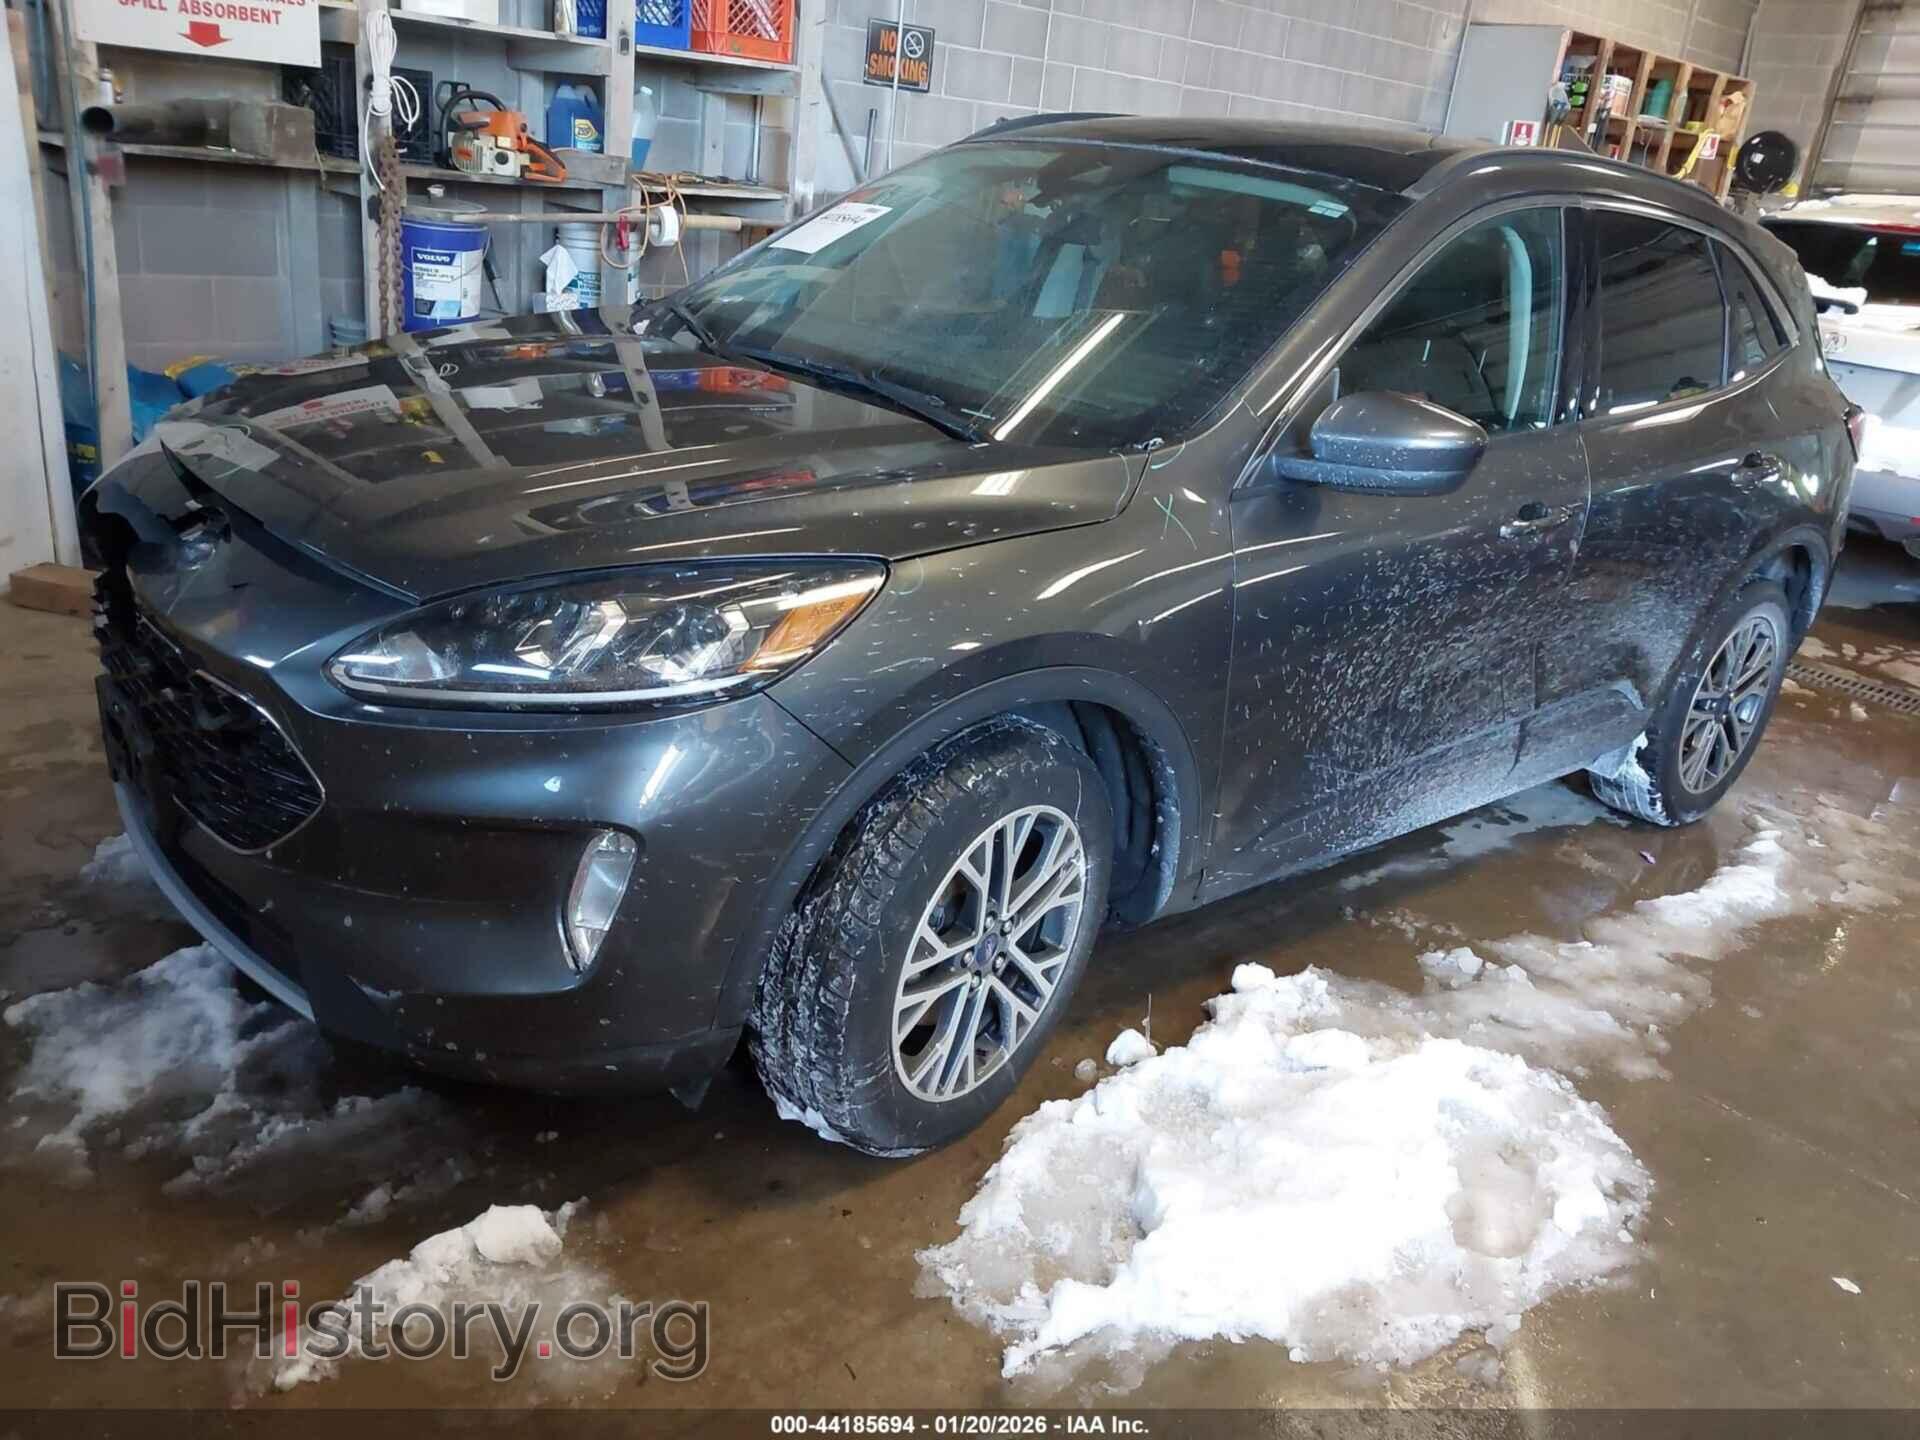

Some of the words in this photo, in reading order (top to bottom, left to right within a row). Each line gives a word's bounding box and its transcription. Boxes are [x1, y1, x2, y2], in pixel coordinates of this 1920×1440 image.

[178, 0, 282, 24] ABSORBENT
[880, 29, 897, 52] NO
[869, 52, 928, 81] SMOKING
[417, 253, 450, 262] VOLVO
